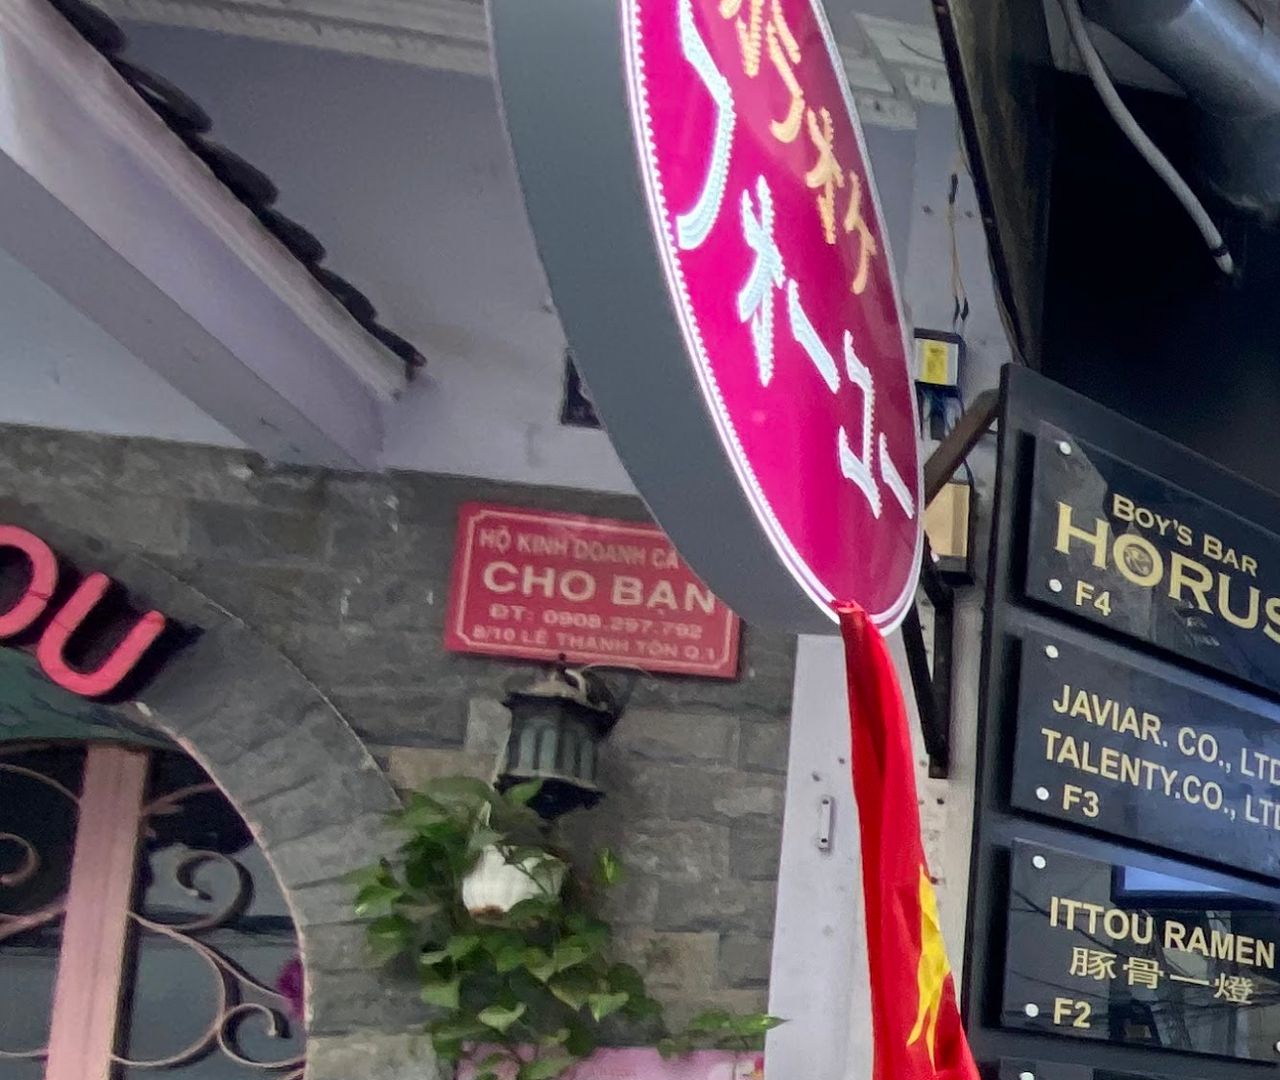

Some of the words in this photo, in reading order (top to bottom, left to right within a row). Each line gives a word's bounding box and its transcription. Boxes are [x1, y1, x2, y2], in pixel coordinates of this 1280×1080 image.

[1113, 494, 1193, 547] BOY'S
[1203, 534, 1258, 577] BAR
[482, 560, 597, 602] CHO
[1075, 580, 1112, 617] F4
[1053, 684, 1168, 748] JAVIAR.
[1062, 784, 1100, 818] F3
[1050, 896, 1153, 945] ITTOU
[1164, 920, 1276, 969] RAMEN
[1069, 947, 1256, 1004] 豚骨一燈
[1053, 997, 1093, 1029] F2
